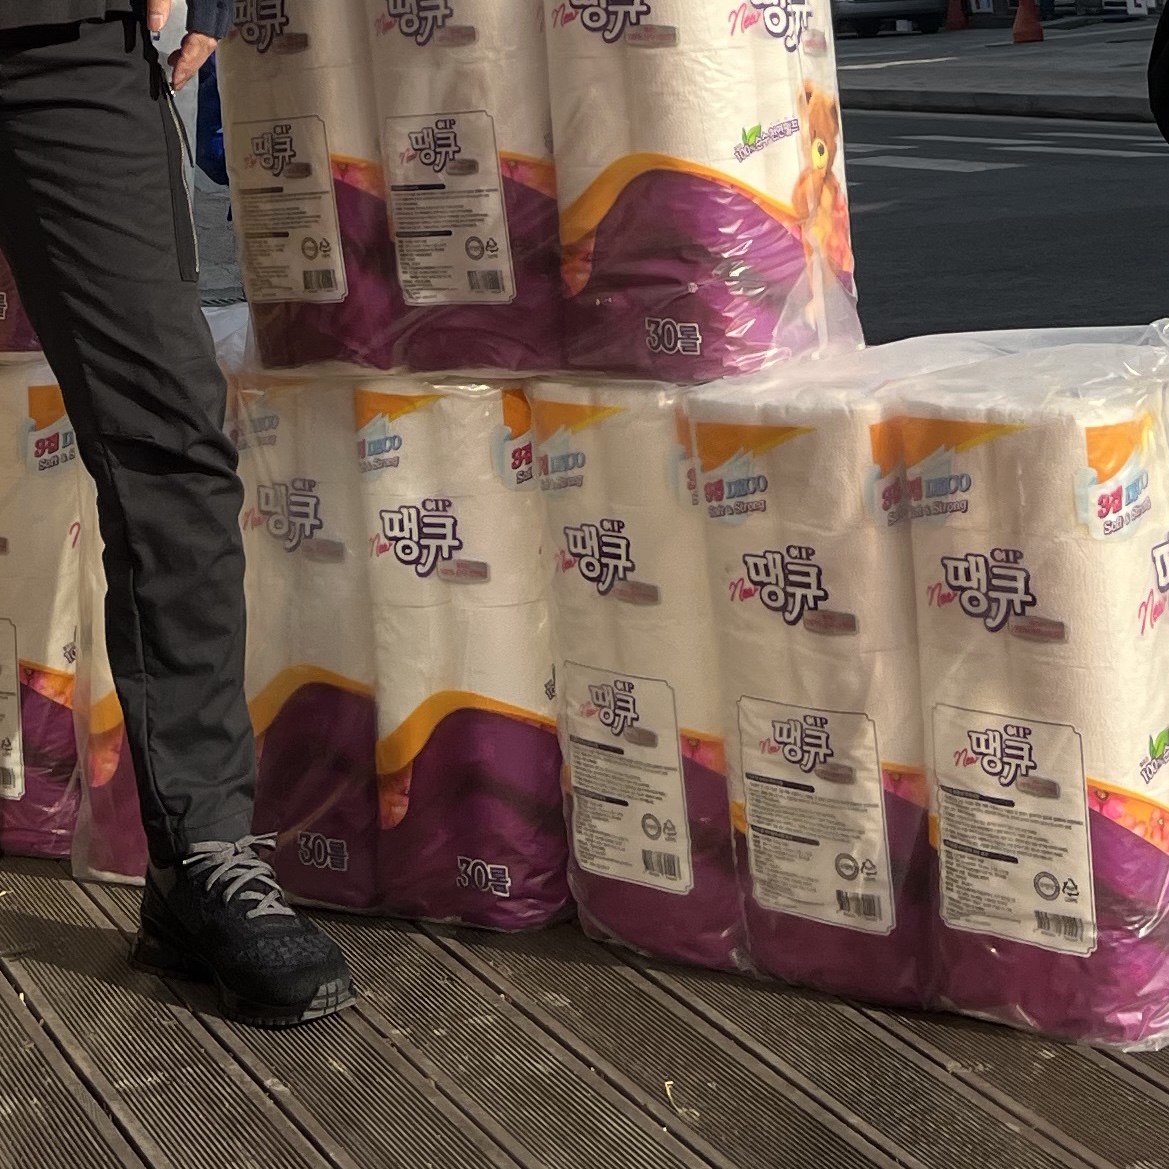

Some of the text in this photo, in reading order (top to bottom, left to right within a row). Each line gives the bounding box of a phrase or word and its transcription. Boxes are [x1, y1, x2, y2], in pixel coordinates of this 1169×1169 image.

[434, 118, 456, 133] CIP
[643, 316, 702, 356] 30롤
[420, 497, 453, 513] CIP
[733, 498, 768, 515] Strong
[932, 498, 969, 517] Strong
[599, 518, 626, 534] CIP
[379, 504, 464, 578] 땡큐
[563, 523, 636, 596] 땡큐
[785, 544, 817, 562] CIP
[989, 546, 1025, 565] CIP
[742, 549, 829, 627] 땡큐
[940, 551, 1038, 633] 땡큐
[802, 714, 830, 730] CIP
[1002, 723, 1033, 742] CIP
[771, 718, 834, 774] 땡큐
[967, 727, 1038, 789] 땡큐
[456, 854, 512, 898] 30롤
